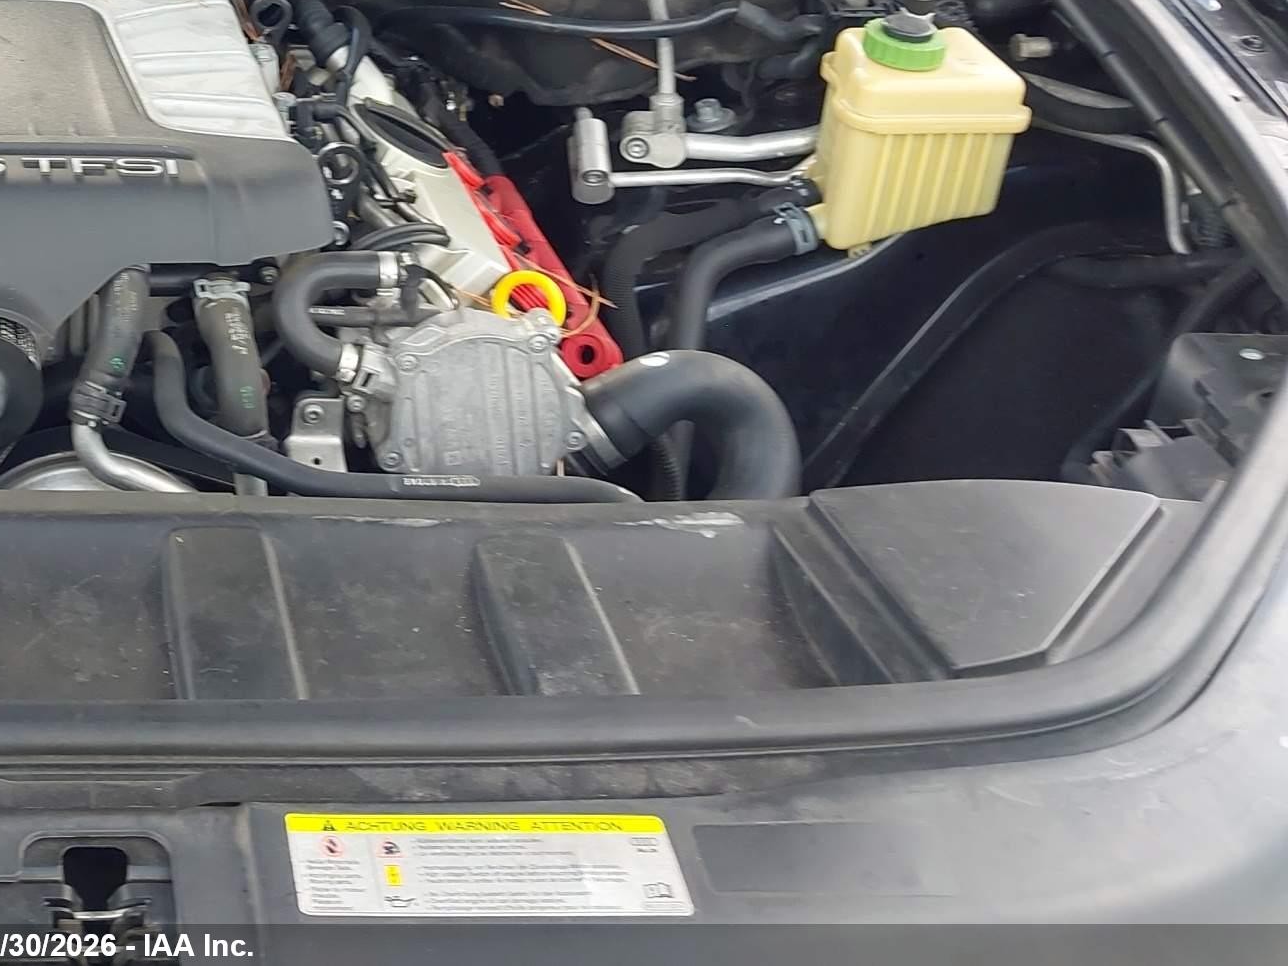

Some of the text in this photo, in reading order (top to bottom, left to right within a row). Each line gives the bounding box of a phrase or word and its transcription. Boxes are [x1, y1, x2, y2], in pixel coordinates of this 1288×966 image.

[20, 156, 180, 177] TFSI
[345, 821, 624, 832] ACHTUNG WARNING ATTENTION
